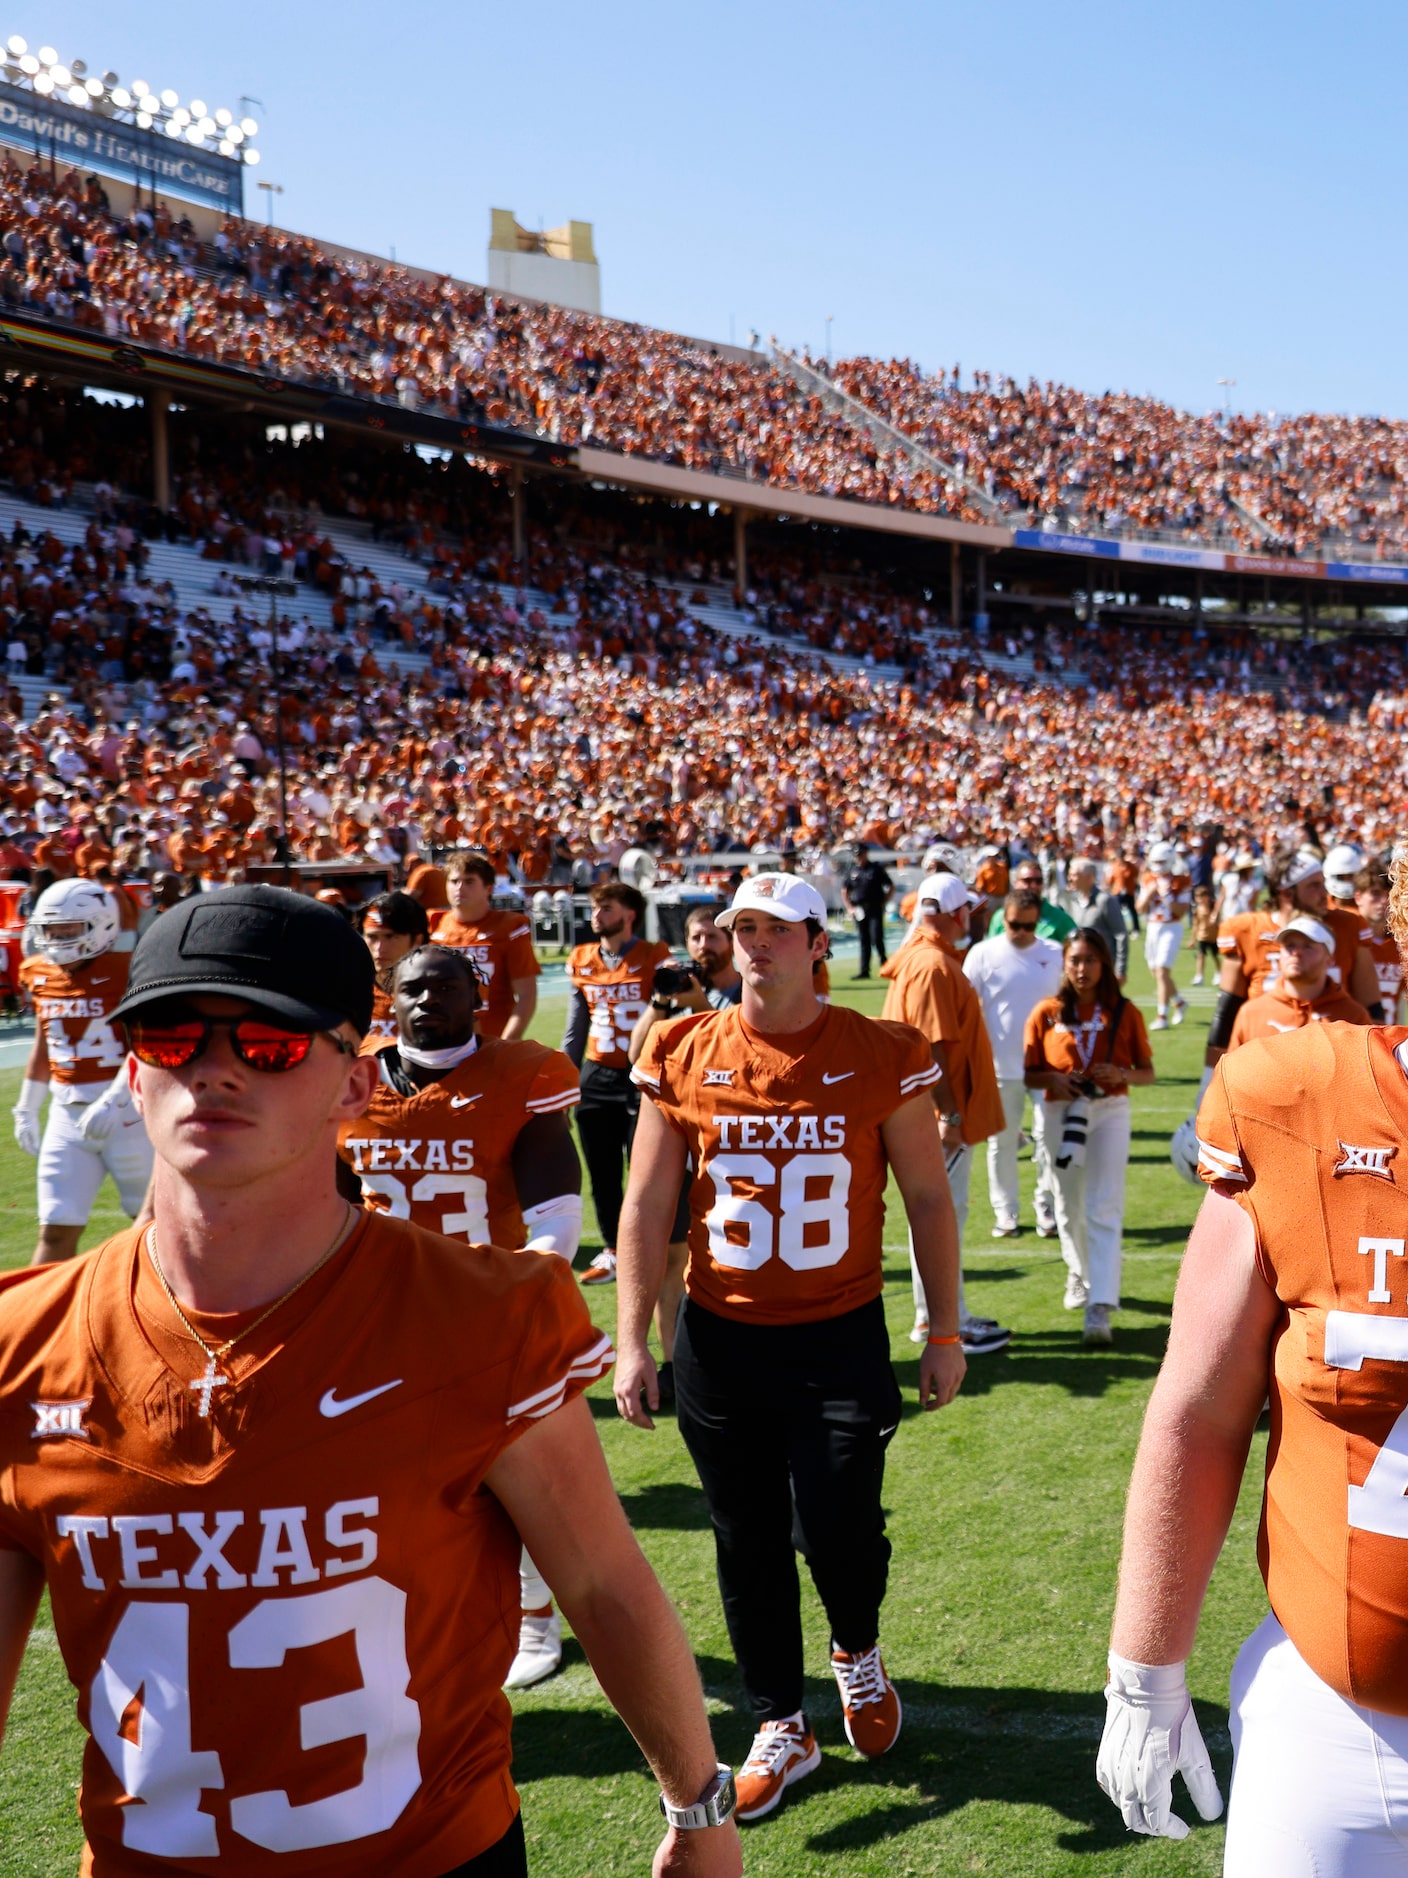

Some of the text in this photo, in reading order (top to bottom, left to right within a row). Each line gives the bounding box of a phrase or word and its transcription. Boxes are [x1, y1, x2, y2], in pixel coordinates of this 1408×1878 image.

[0, 101, 88, 147] David's
[39, 998, 104, 1018] TEXAS
[583, 983, 641, 1003] TEXAS
[712, 1115, 846, 1149] TEXAS
[344, 1138, 475, 1171] TEXAS
[1335, 1140, 1397, 1180] XII
[706, 1152, 852, 1271] 68
[30, 1400, 89, 1438] XII
[56, 1496, 379, 1590] TEXAS
[90, 1575, 423, 1858] 43
